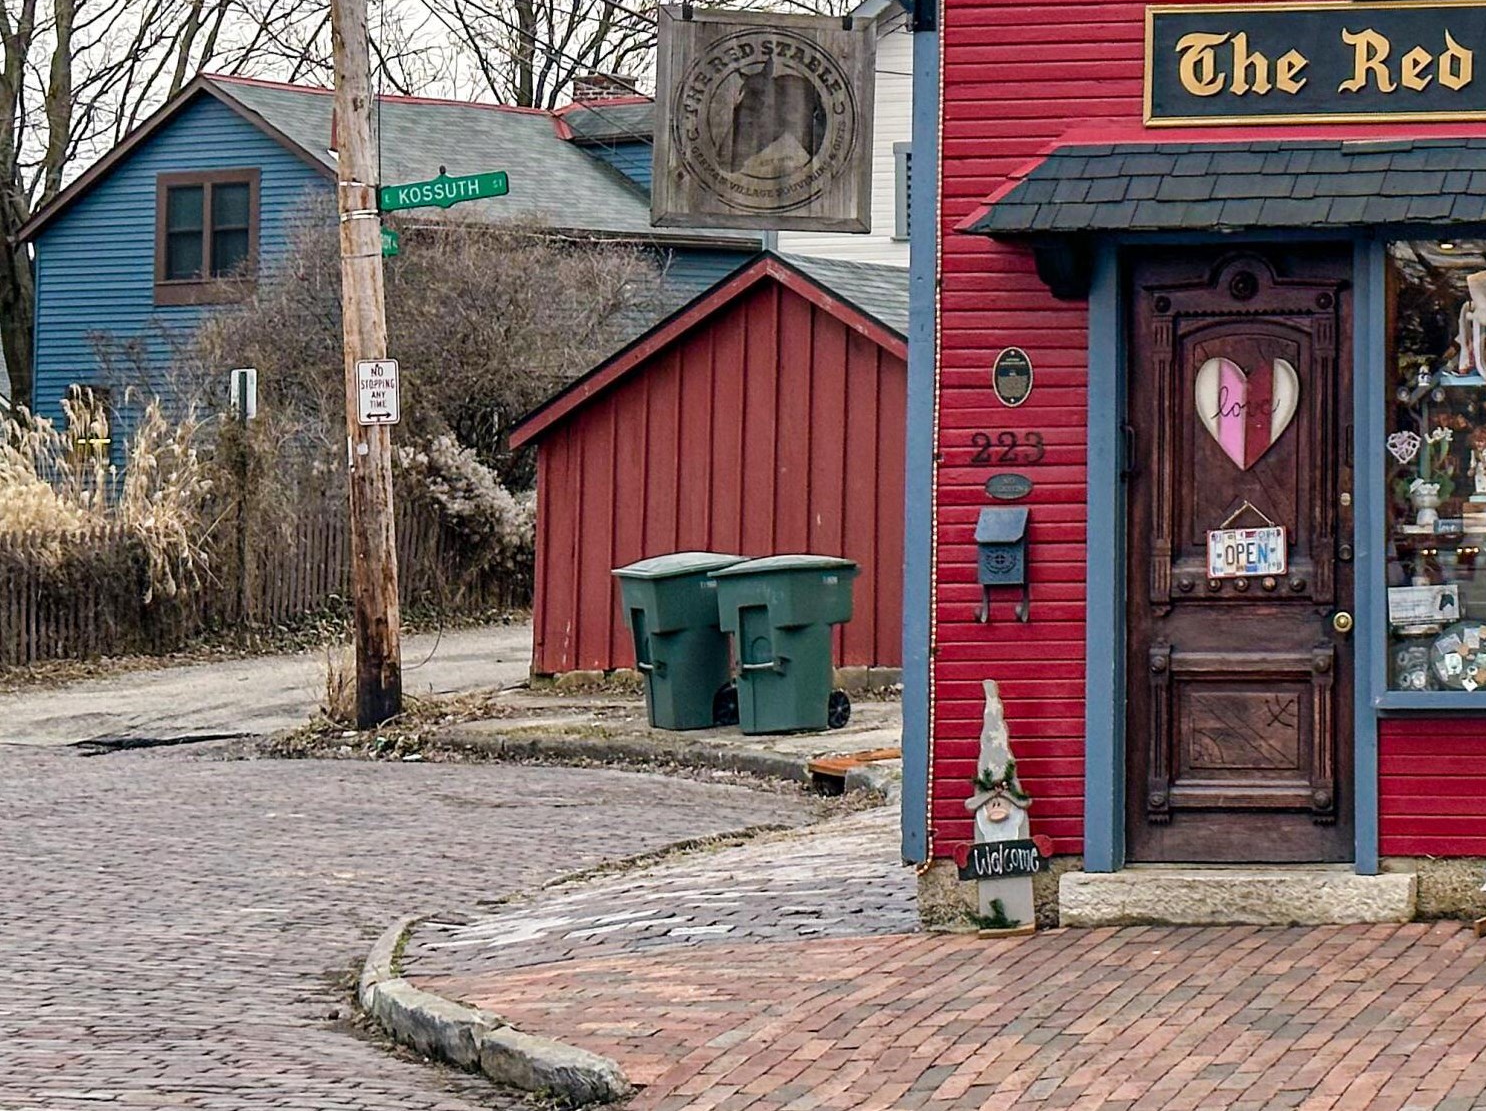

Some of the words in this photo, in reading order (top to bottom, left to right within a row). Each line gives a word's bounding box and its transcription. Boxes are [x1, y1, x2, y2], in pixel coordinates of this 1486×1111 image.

[707, 43, 755, 73] RED
[761, 40, 843, 96] STABLE
[1174, 30, 1311, 98] The
[1336, 27, 1476, 94] Red
[399, 179, 480, 205] KOSSUTH
[361, 379, 395, 390] STOPPING
[371, 366, 384, 377] NO
[371, 391, 386, 399] ANY
[971, 431, 1045, 464] 223
[1225, 542, 1268, 566] OPEN
[973, 844, 1040, 876] Welcome
